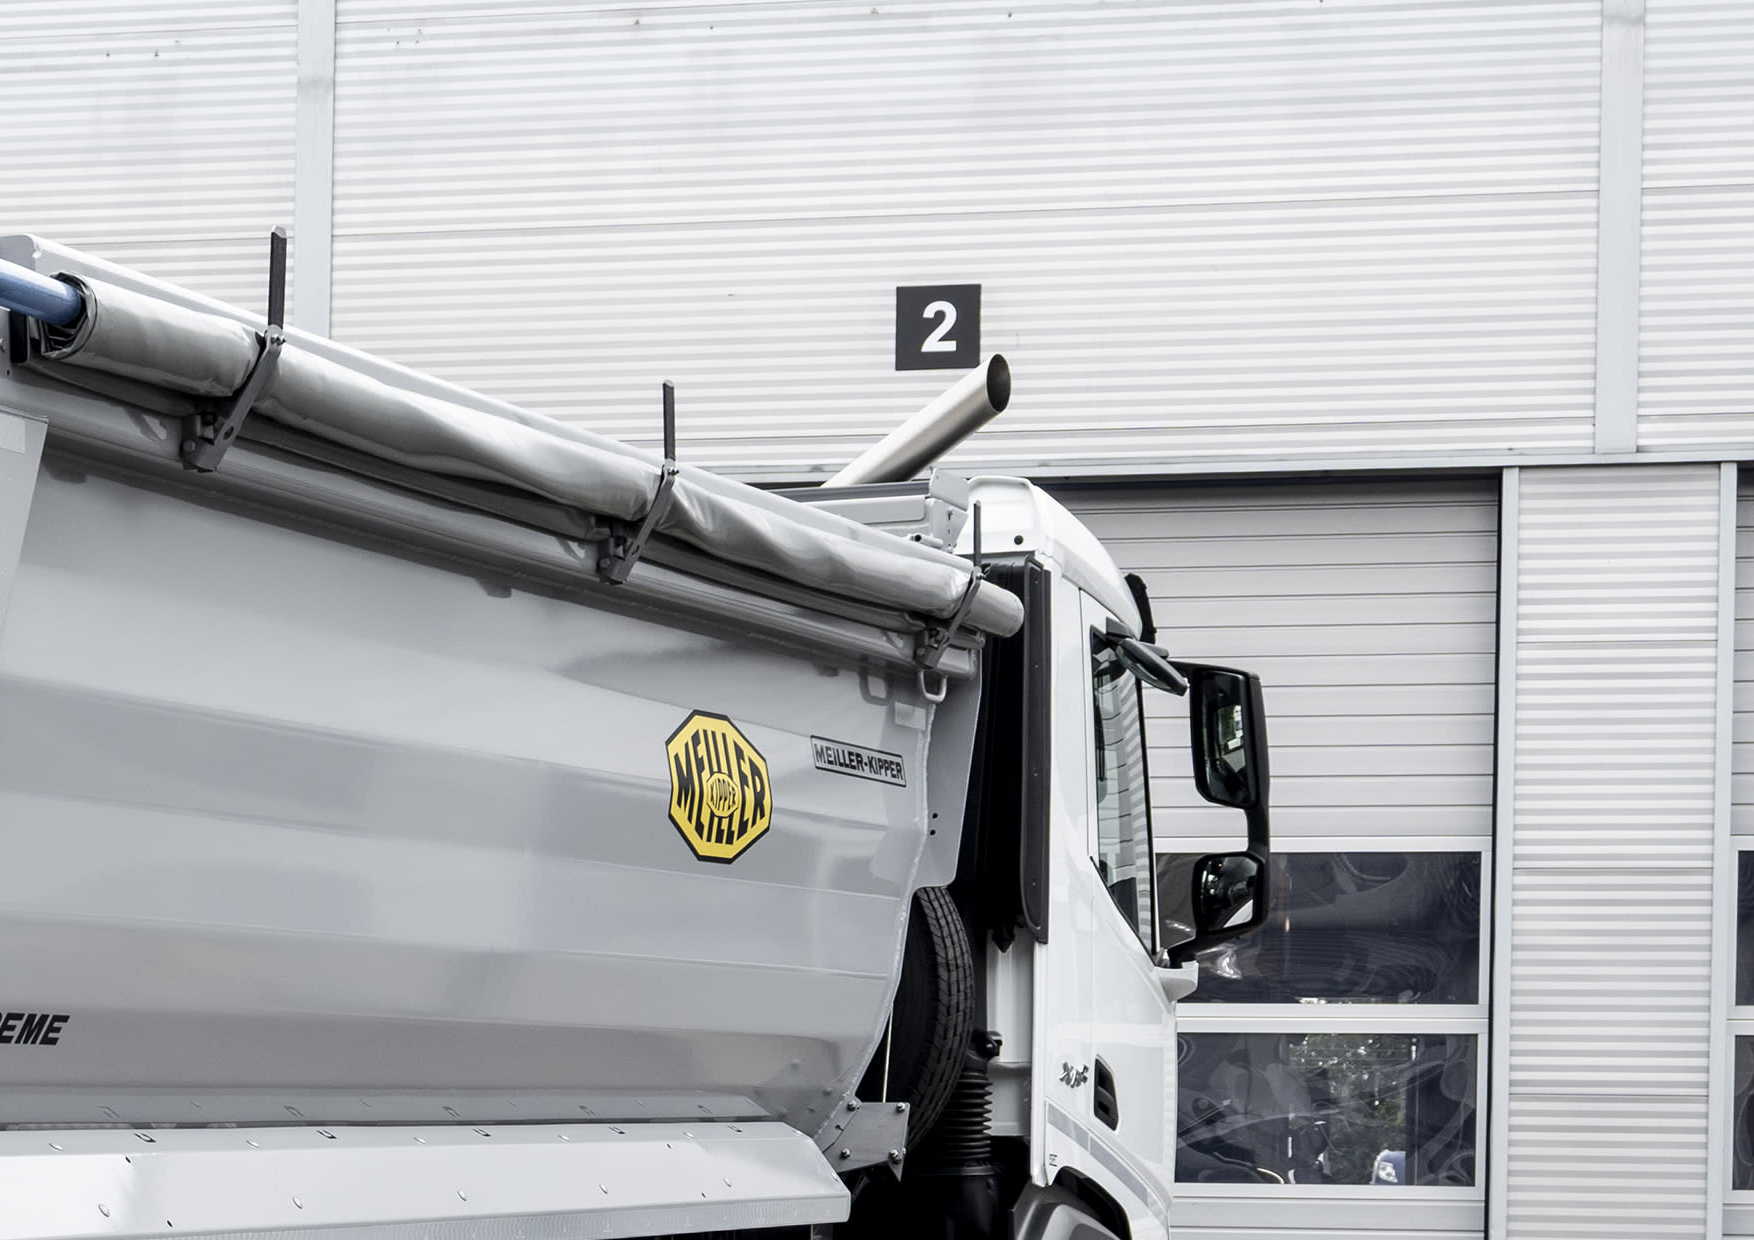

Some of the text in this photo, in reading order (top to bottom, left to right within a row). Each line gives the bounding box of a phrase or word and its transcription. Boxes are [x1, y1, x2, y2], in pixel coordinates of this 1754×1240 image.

[921, 301, 957, 353] 2
[673, 728, 766, 846] MEILLER
[710, 777, 736, 813] KIPPER
